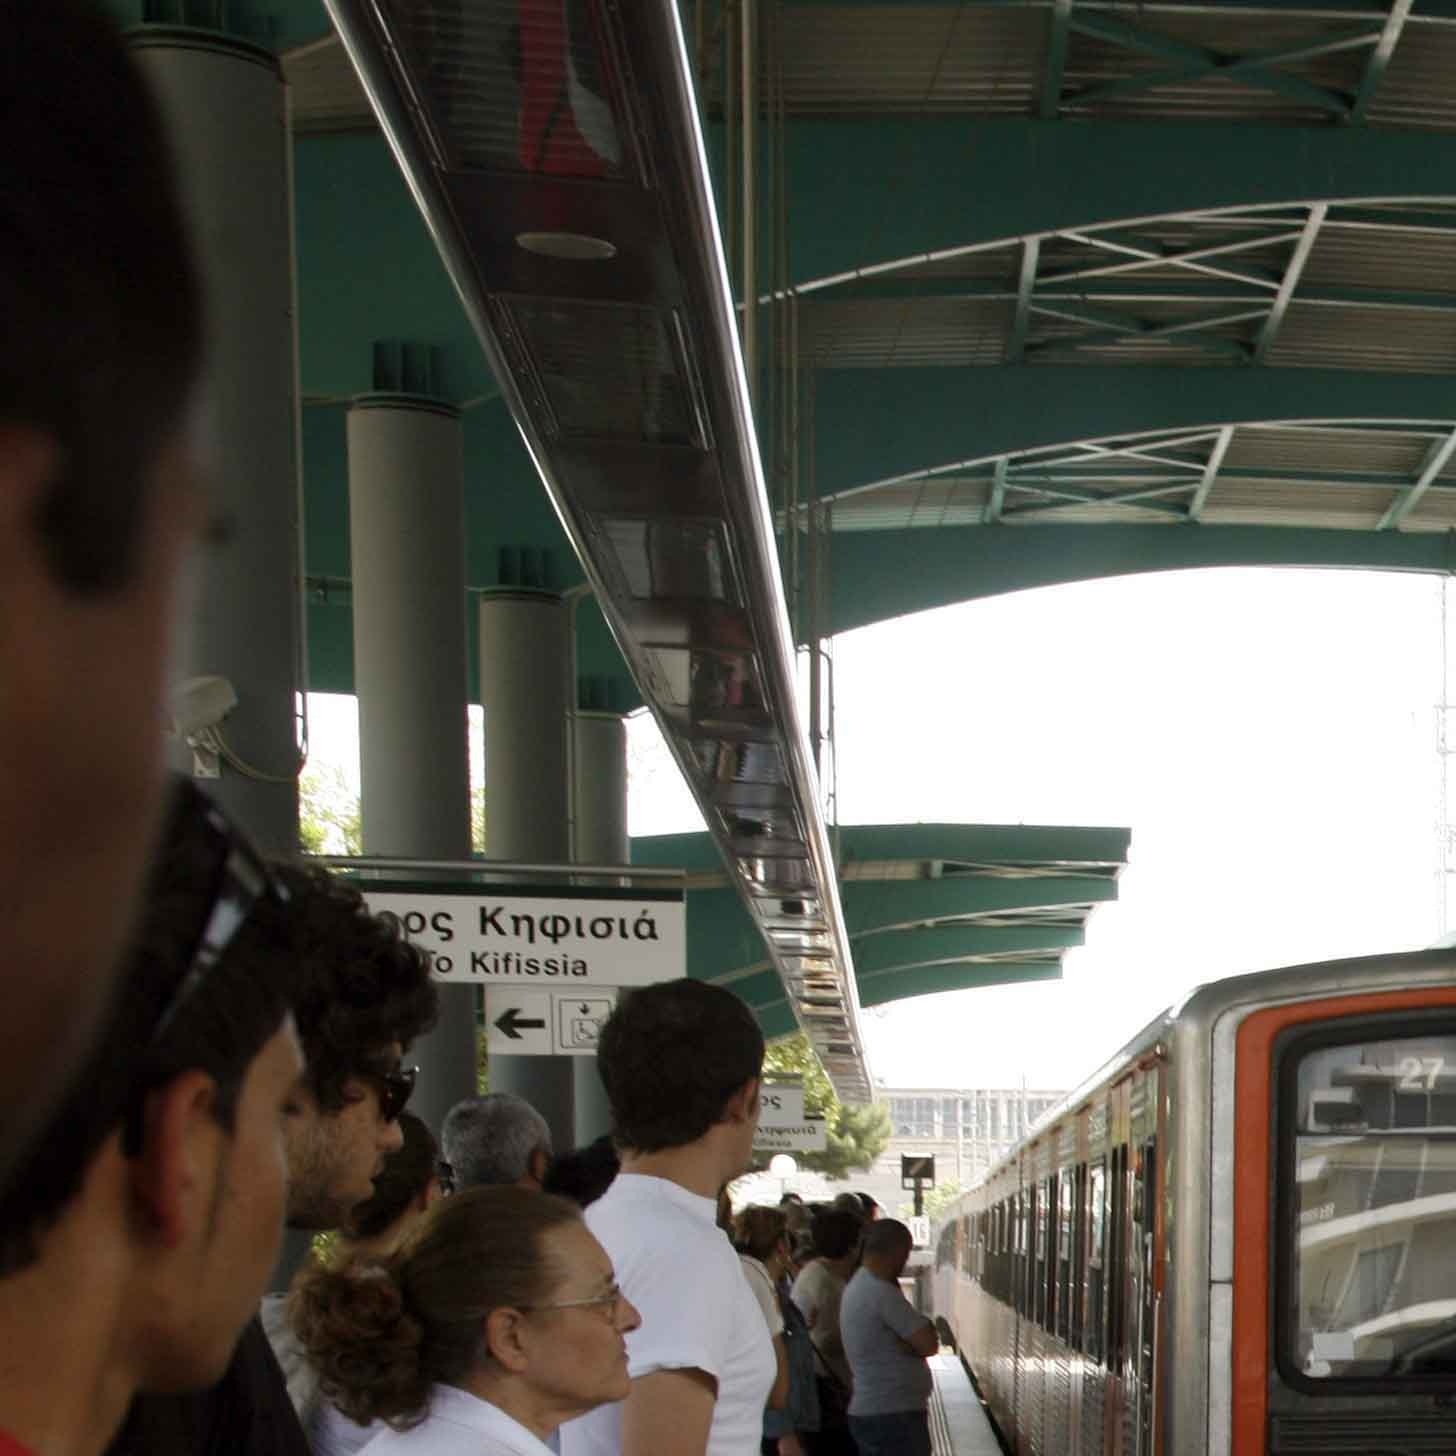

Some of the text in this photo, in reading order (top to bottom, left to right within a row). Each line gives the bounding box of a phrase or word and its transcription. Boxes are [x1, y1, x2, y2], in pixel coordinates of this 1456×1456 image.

[403, 905, 659, 945] ος Κηφισιά
[470, 951, 588, 977] Kifissia
[1400, 1057, 1445, 1089] 27
